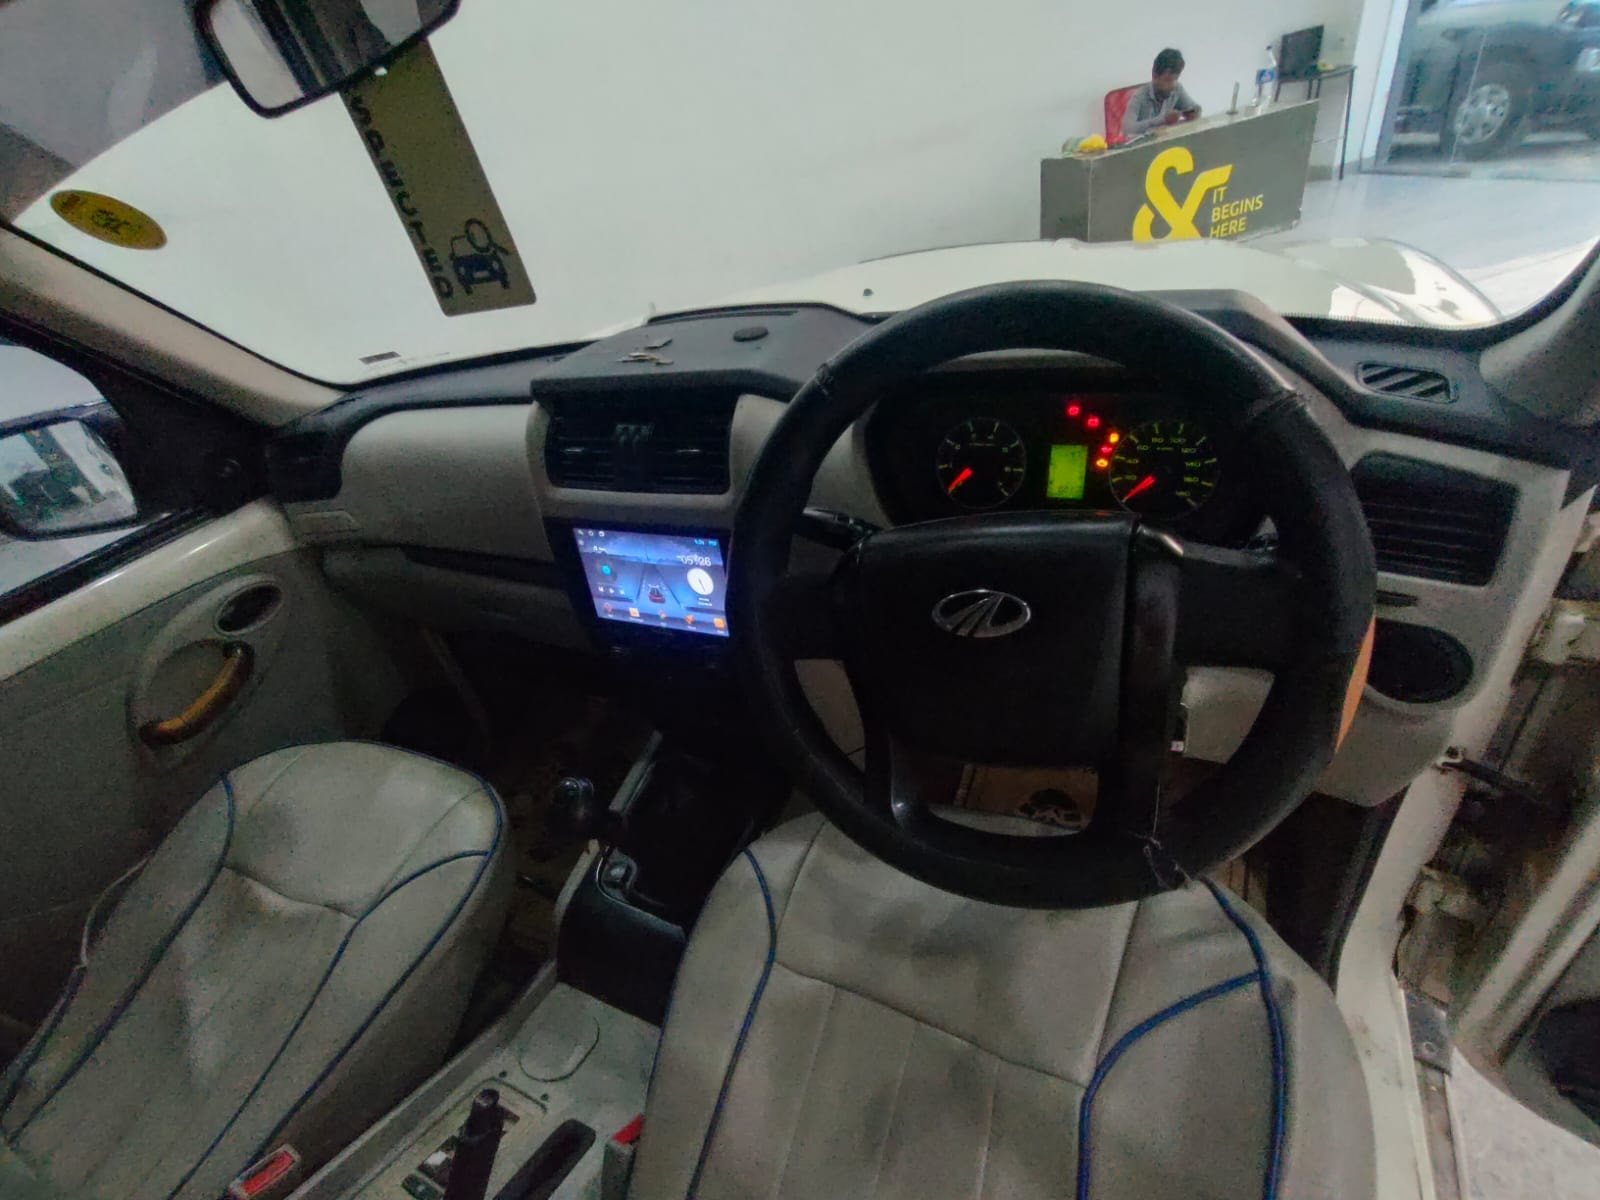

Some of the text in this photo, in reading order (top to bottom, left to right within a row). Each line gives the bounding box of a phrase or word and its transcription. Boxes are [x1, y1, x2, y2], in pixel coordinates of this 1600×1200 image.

[1212, 186, 1228, 205] IT
[1211, 194, 1264, 223] BEGINS
[1209, 216, 1248, 239] HERE
